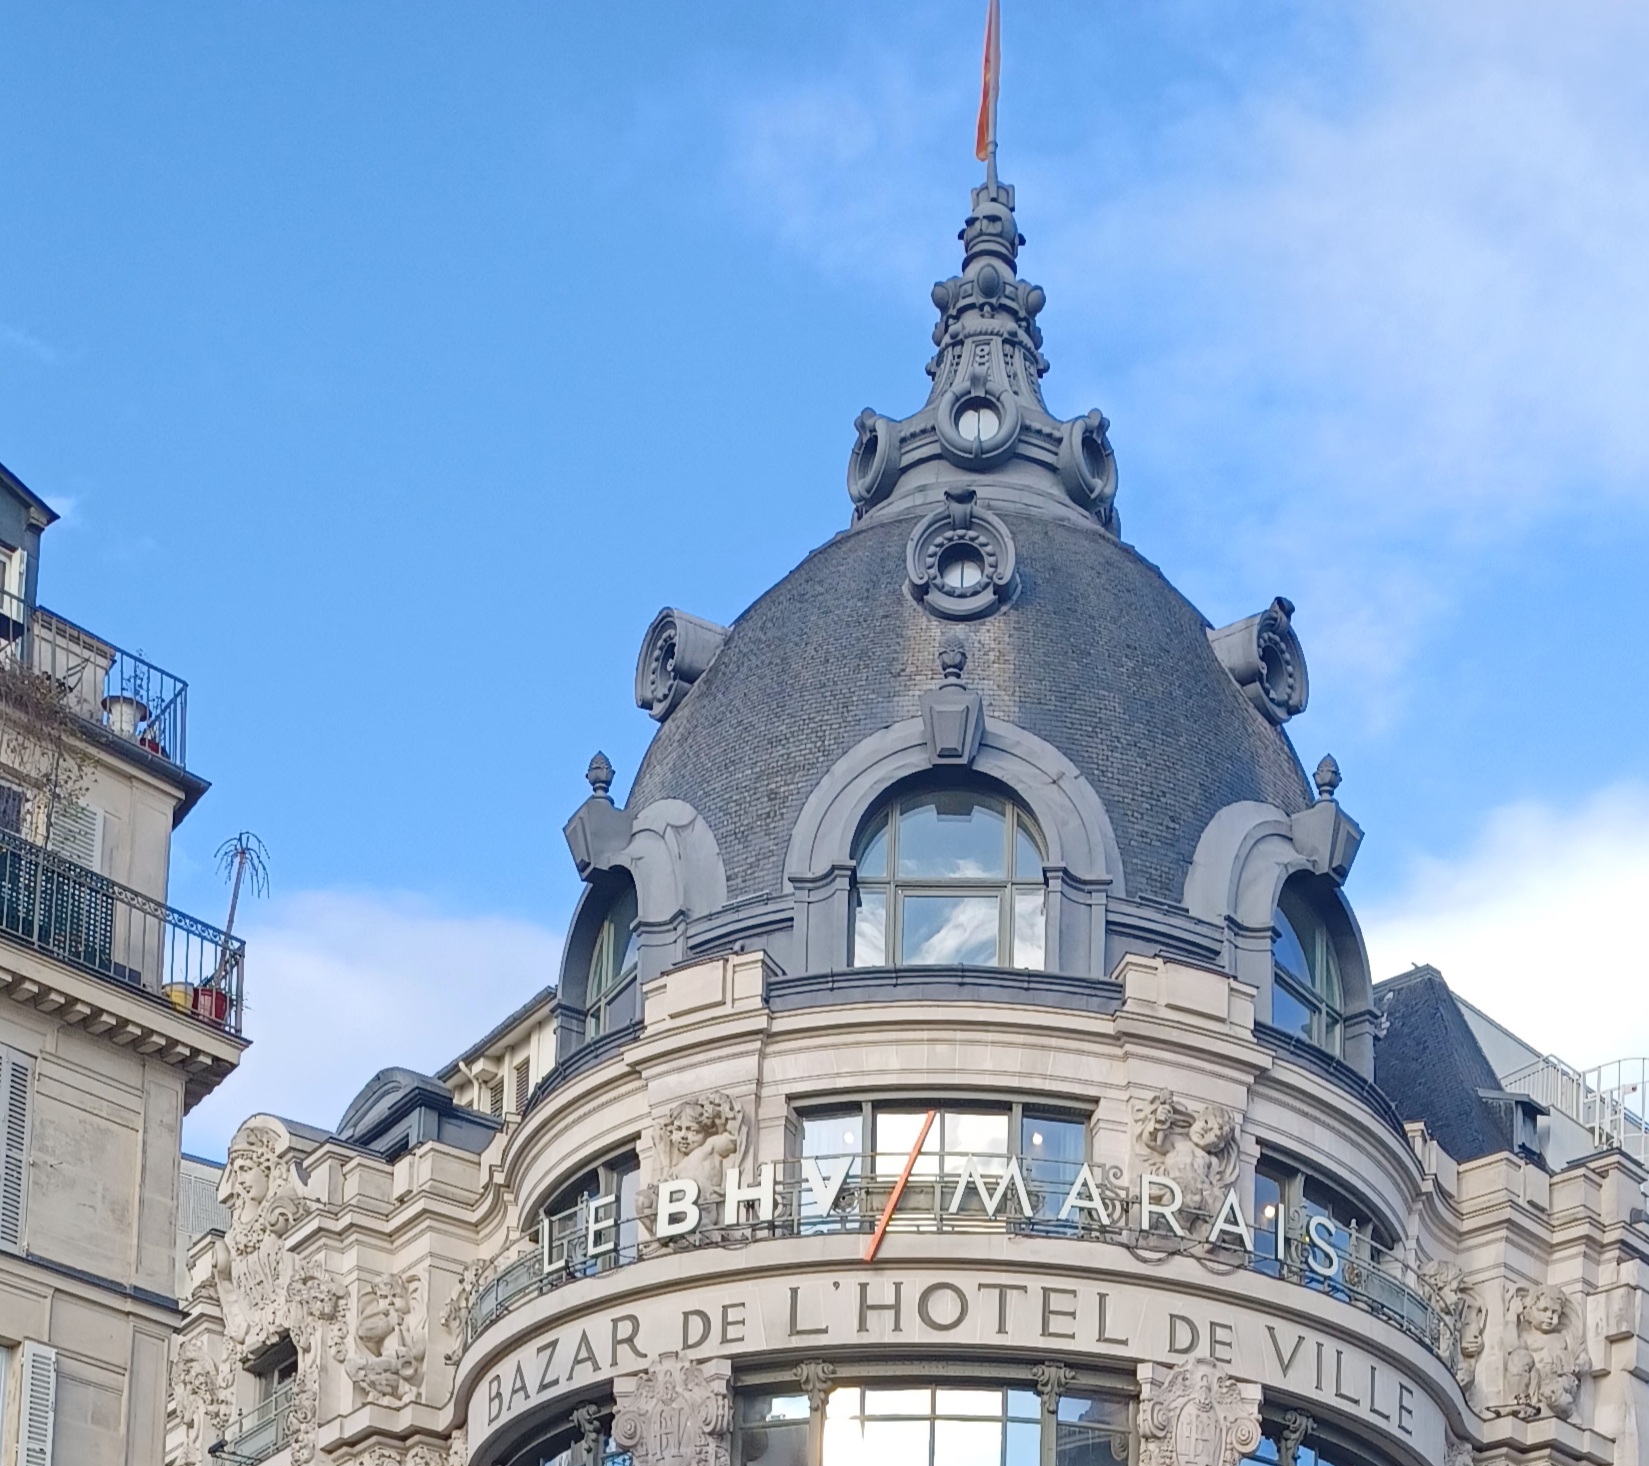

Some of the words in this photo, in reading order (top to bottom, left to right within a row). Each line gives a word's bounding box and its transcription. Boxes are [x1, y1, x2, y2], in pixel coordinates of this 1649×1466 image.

[543, 1194, 618, 1273] LE
[657, 1156, 854, 1239] BHV
[948, 1154, 1339, 1277] MARAIS
[487, 1313, 648, 1427] BAZAR
[682, 1302, 746, 1351] DE
[788, 1280, 1129, 1346] L'HOTEL
[1168, 1313, 1234, 1364] DE
[1265, 1324, 1414, 1437] VILLE
